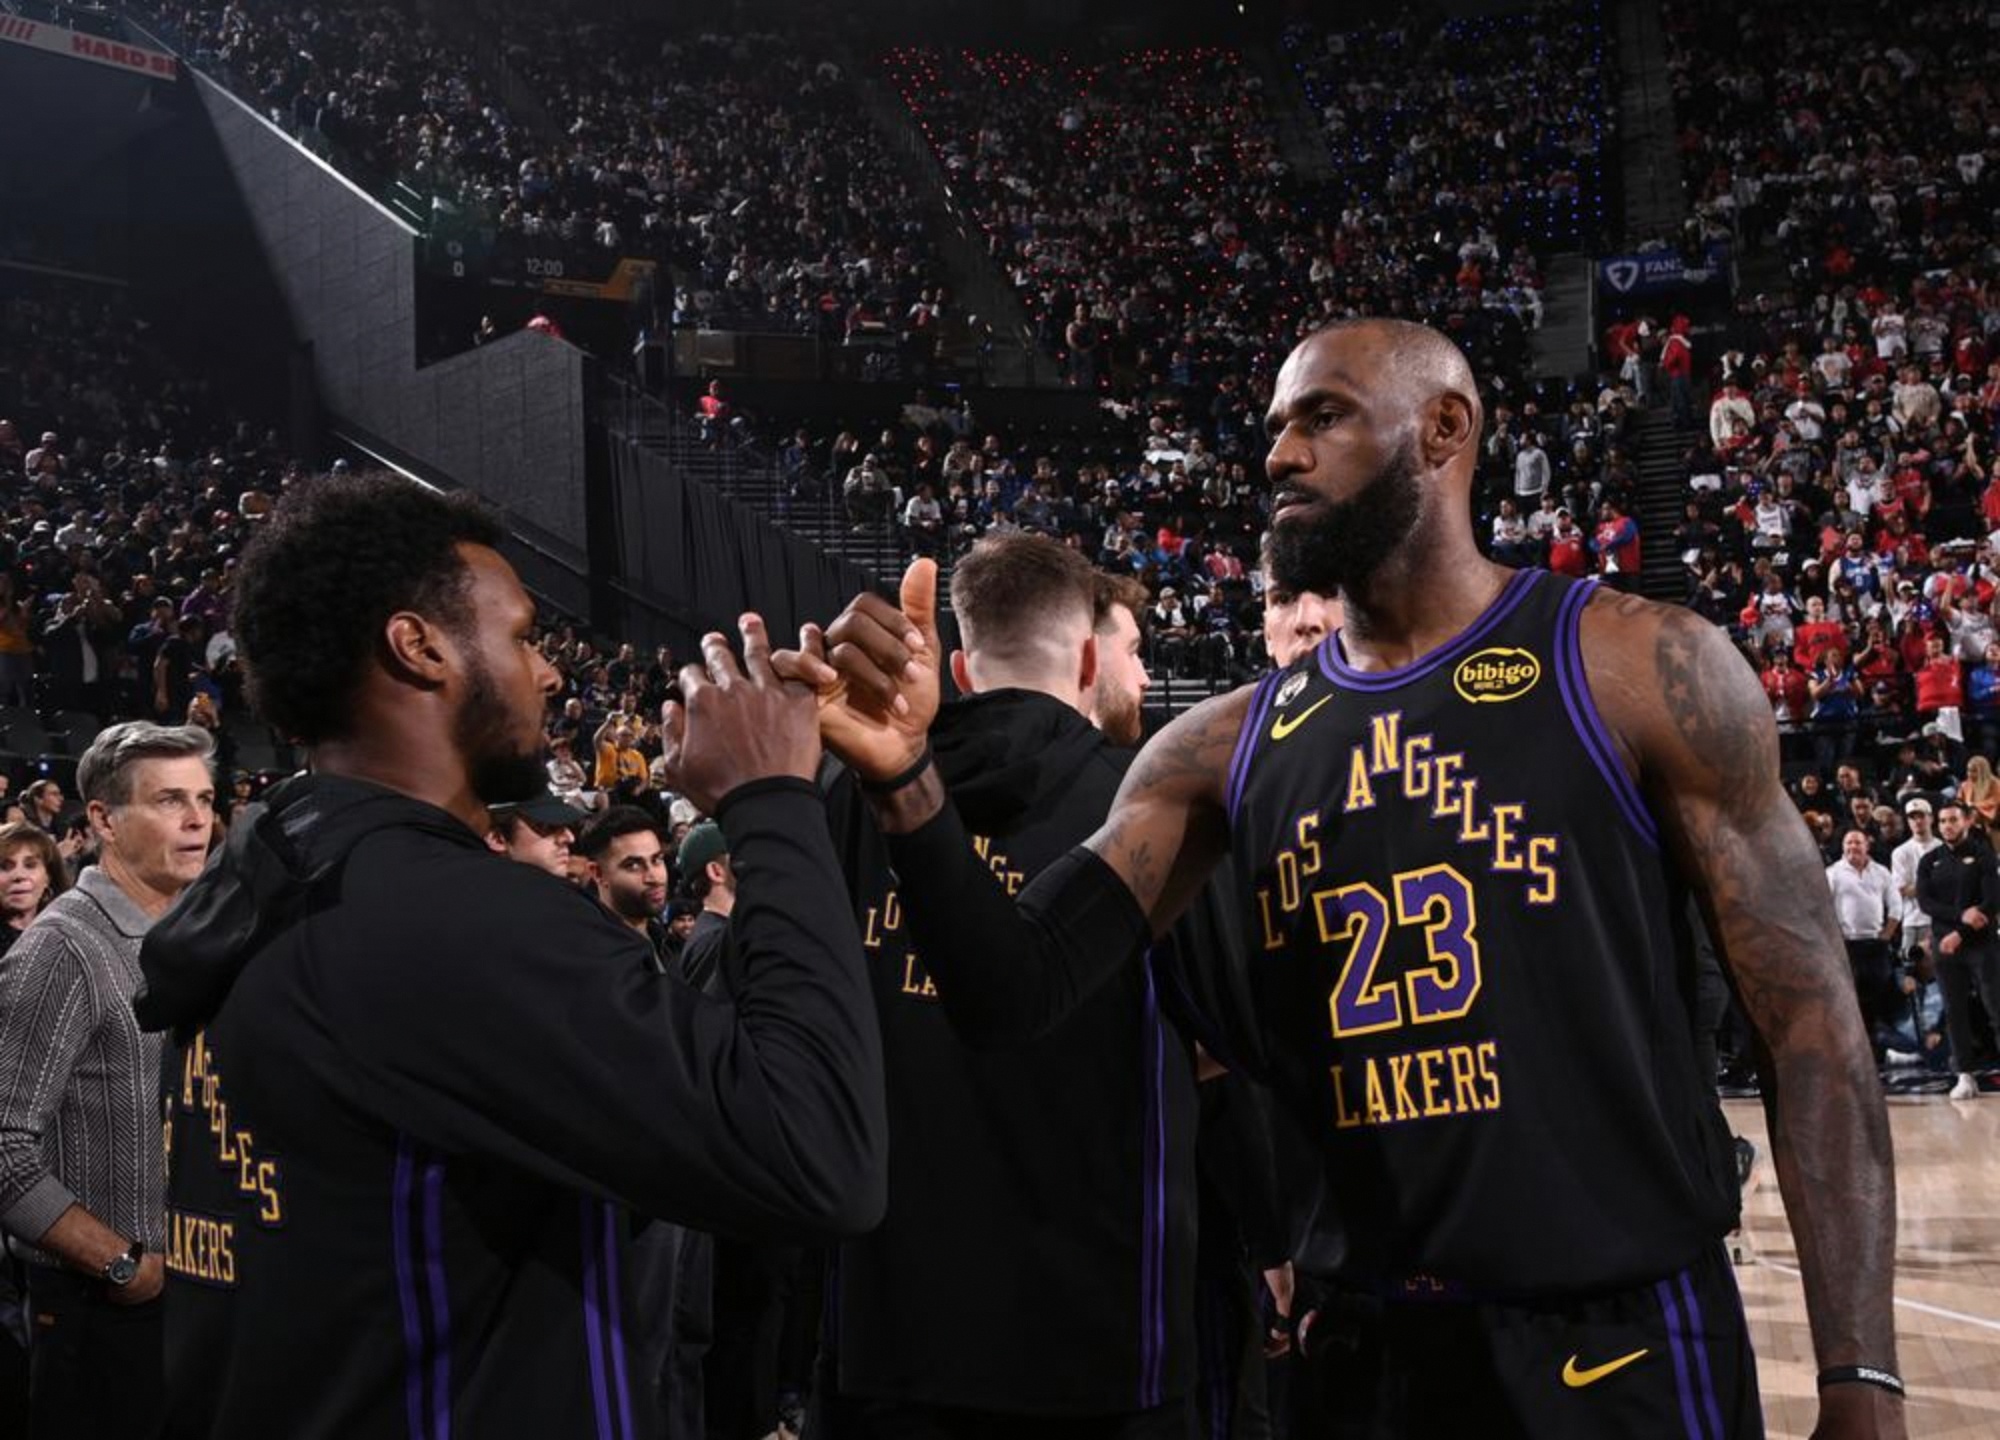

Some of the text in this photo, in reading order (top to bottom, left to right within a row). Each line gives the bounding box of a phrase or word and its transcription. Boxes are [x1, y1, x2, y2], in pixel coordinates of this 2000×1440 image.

[72, 34, 147, 67] HARD
[525, 257, 564, 277] 12:00
[1461, 661, 1535, 685] bibigo
[1259, 711, 1558, 950] LOS ANGELES
[864, 891, 901, 947] LO
[1312, 862, 1482, 1039] 23
[1330, 1042, 1501, 1129] LAKERS
[164, 1211, 235, 1283] LAKERS
